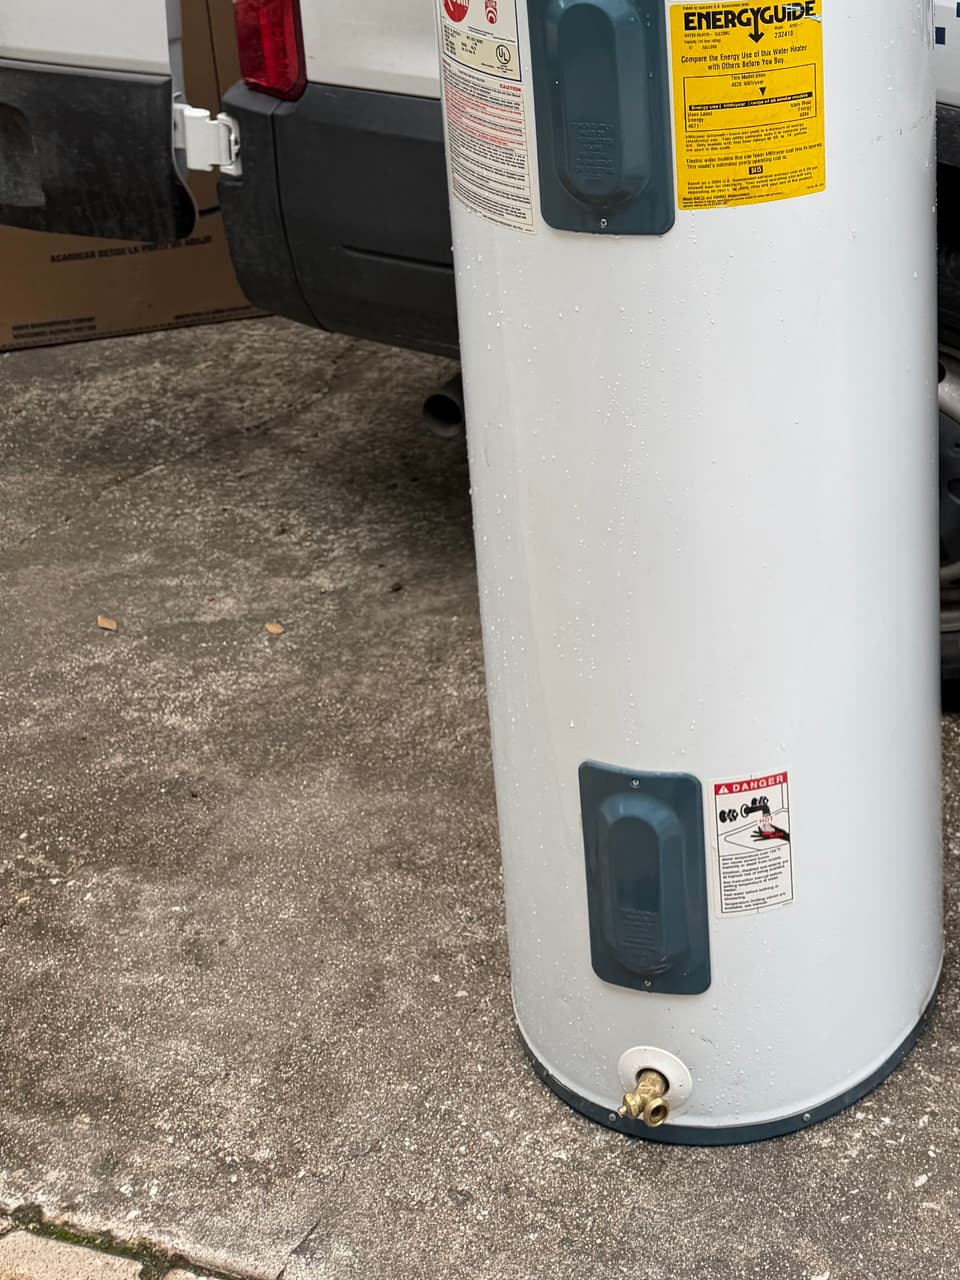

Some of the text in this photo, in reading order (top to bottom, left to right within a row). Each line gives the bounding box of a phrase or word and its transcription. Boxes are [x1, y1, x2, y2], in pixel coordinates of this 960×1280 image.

[681, 55, 707, 64] Compare
[720, 53, 740, 61] Energy
[742, 51, 752, 59] Use
[722, 62, 740, 70] Others
[499, 83, 521, 92] CAUTION
[733, 775, 784, 792] DANGER
